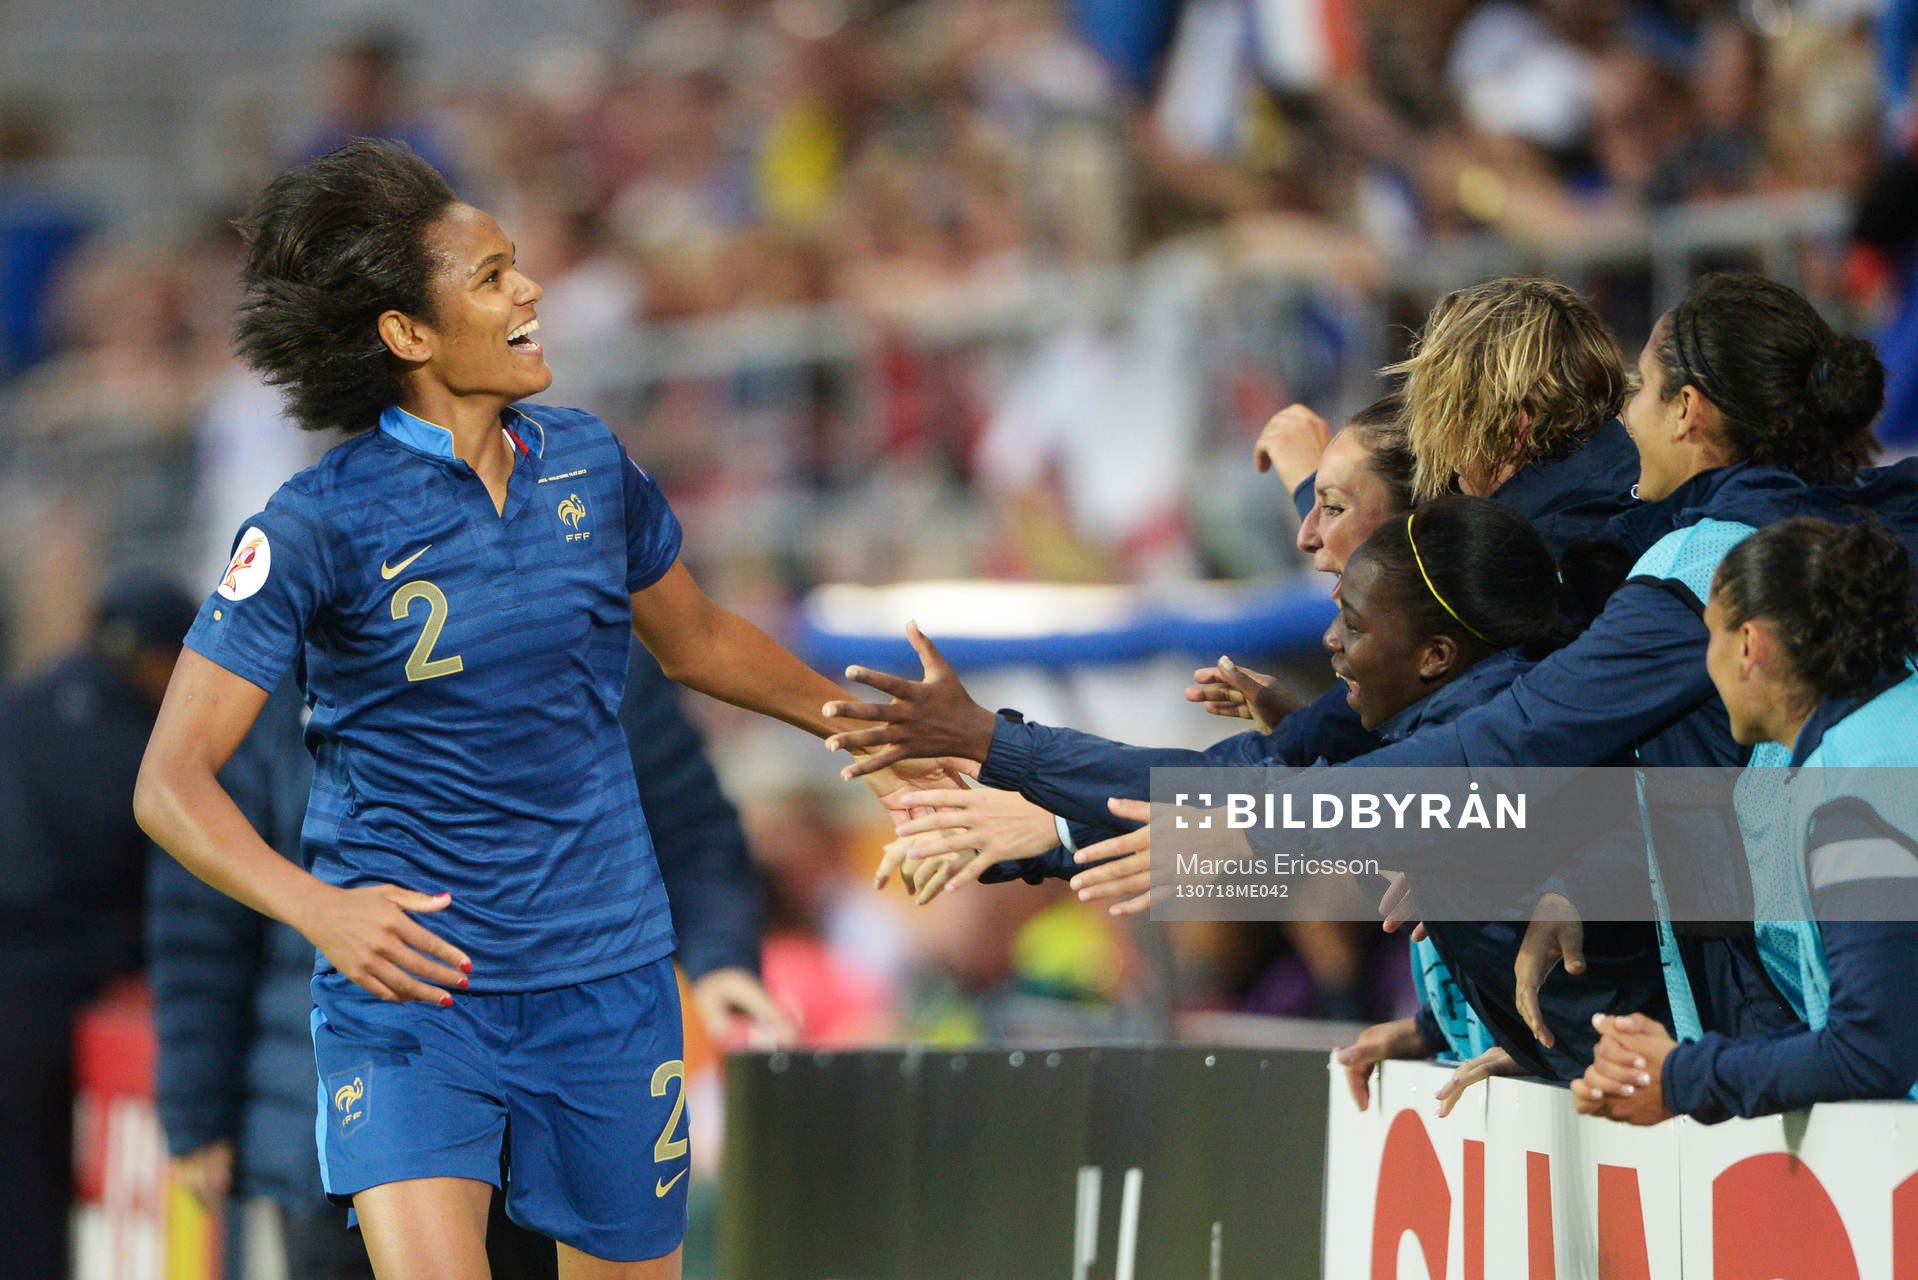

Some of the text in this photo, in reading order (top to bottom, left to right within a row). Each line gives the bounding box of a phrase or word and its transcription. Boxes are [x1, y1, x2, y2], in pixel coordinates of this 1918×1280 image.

[566, 531, 590, 543] FFF
[390, 580, 464, 682] 2
[650, 1059, 688, 1164] 2
